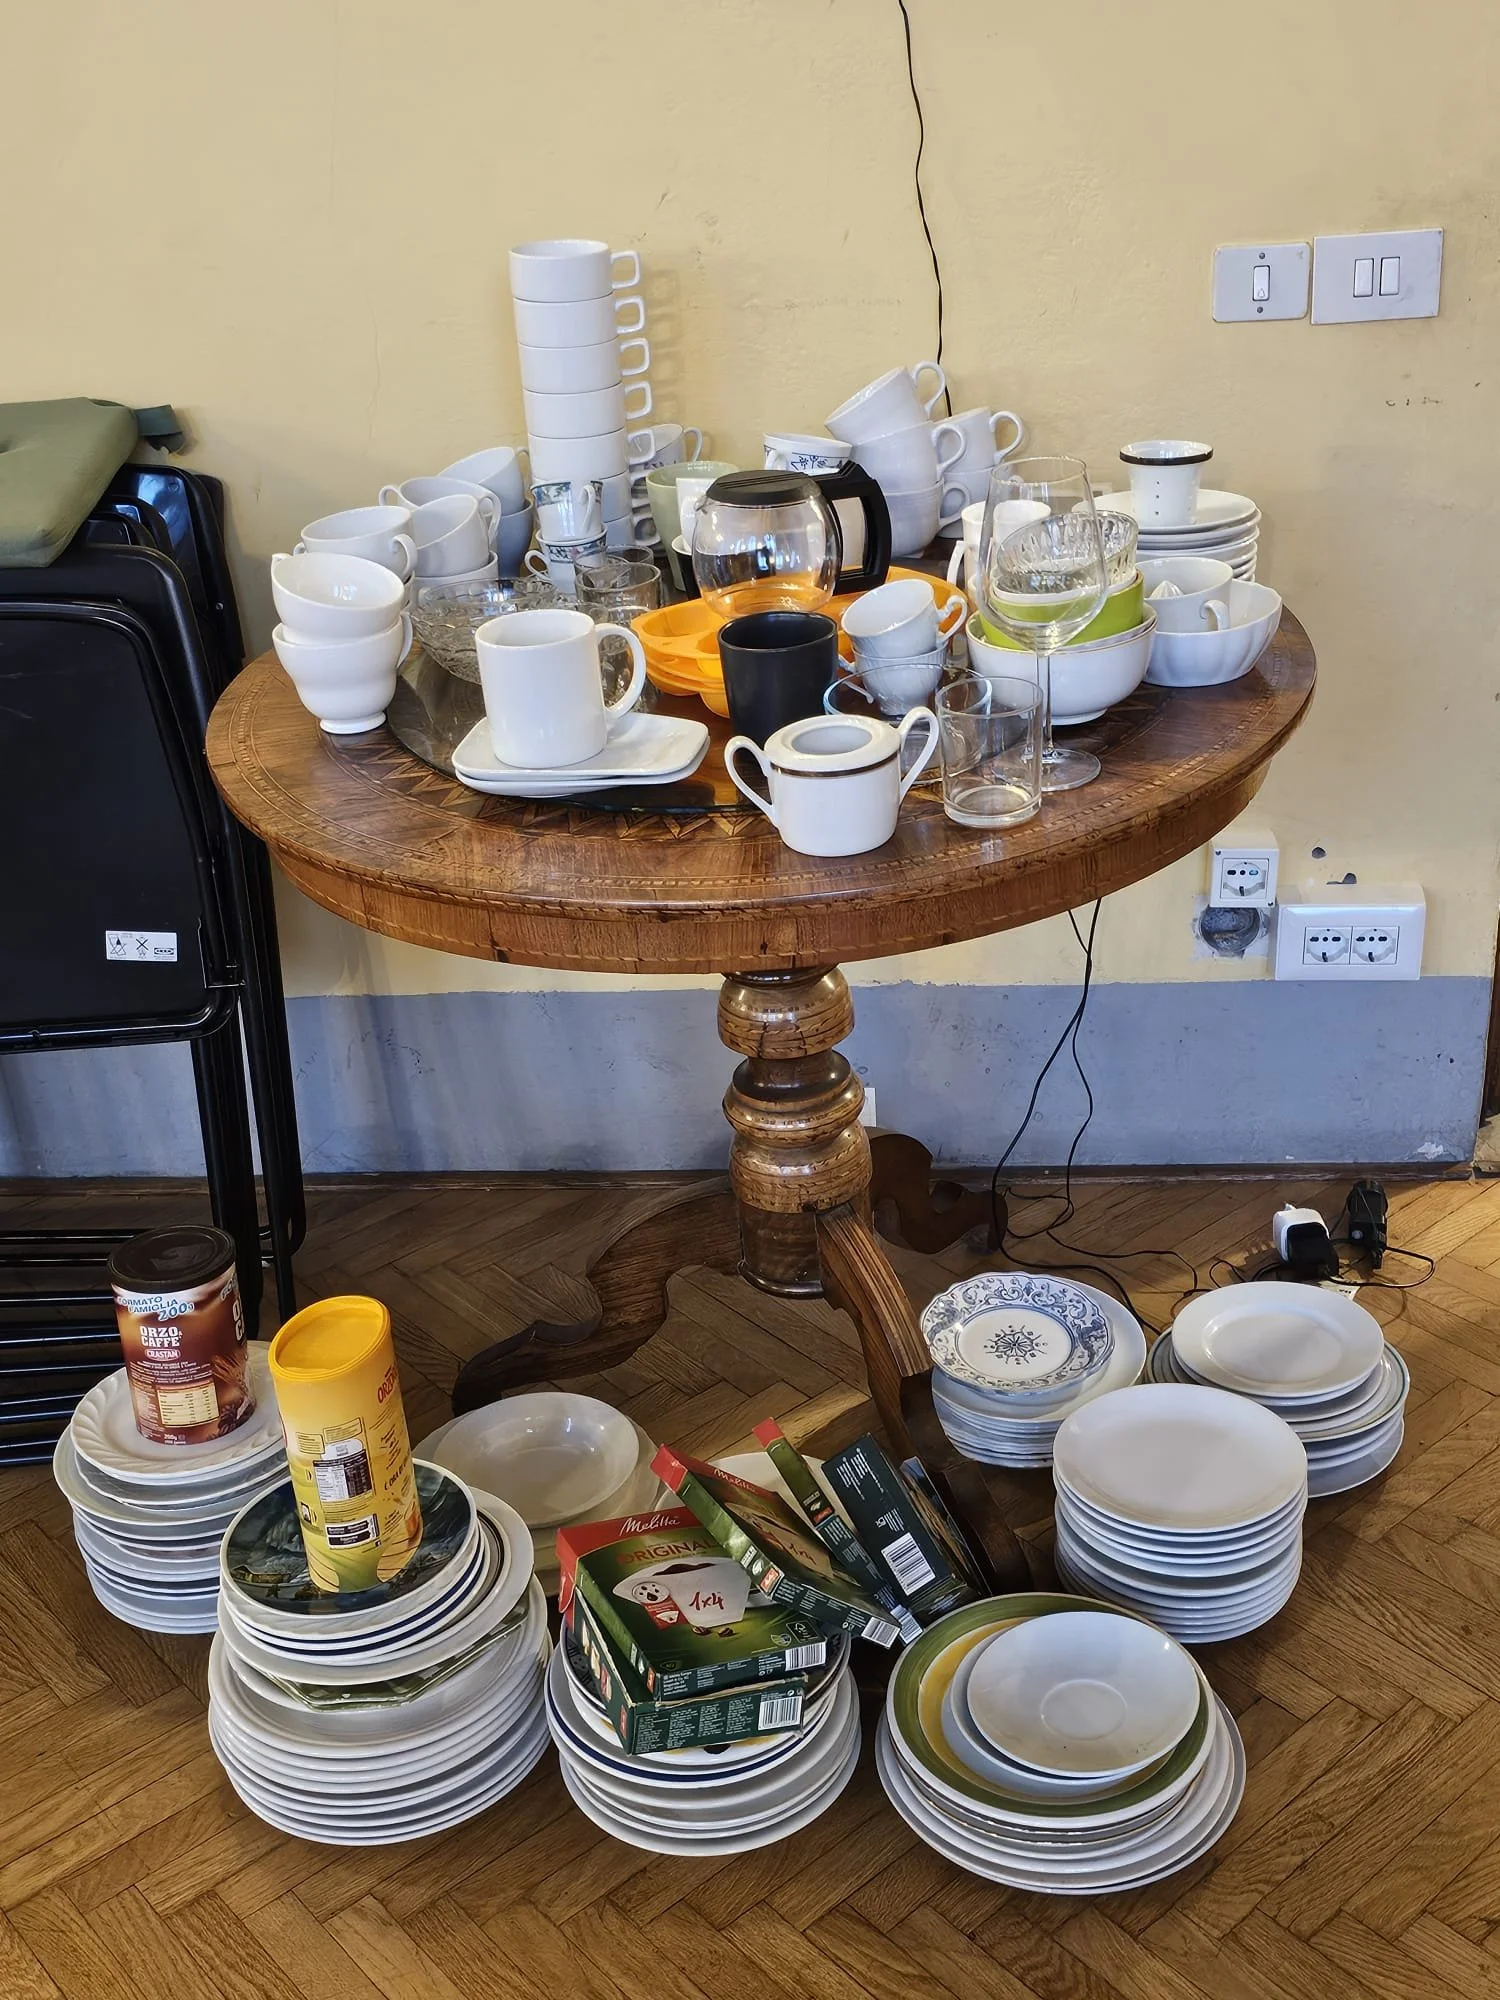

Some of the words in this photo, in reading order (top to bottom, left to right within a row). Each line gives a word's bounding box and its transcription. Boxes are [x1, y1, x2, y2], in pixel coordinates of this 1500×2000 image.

[129, 1299, 178, 1313] FAMIGLIA
[140, 1326, 178, 1338] ORZO
[146, 1350, 178, 1359] CRASTAN
[619, 1514, 680, 1537] Melitta
